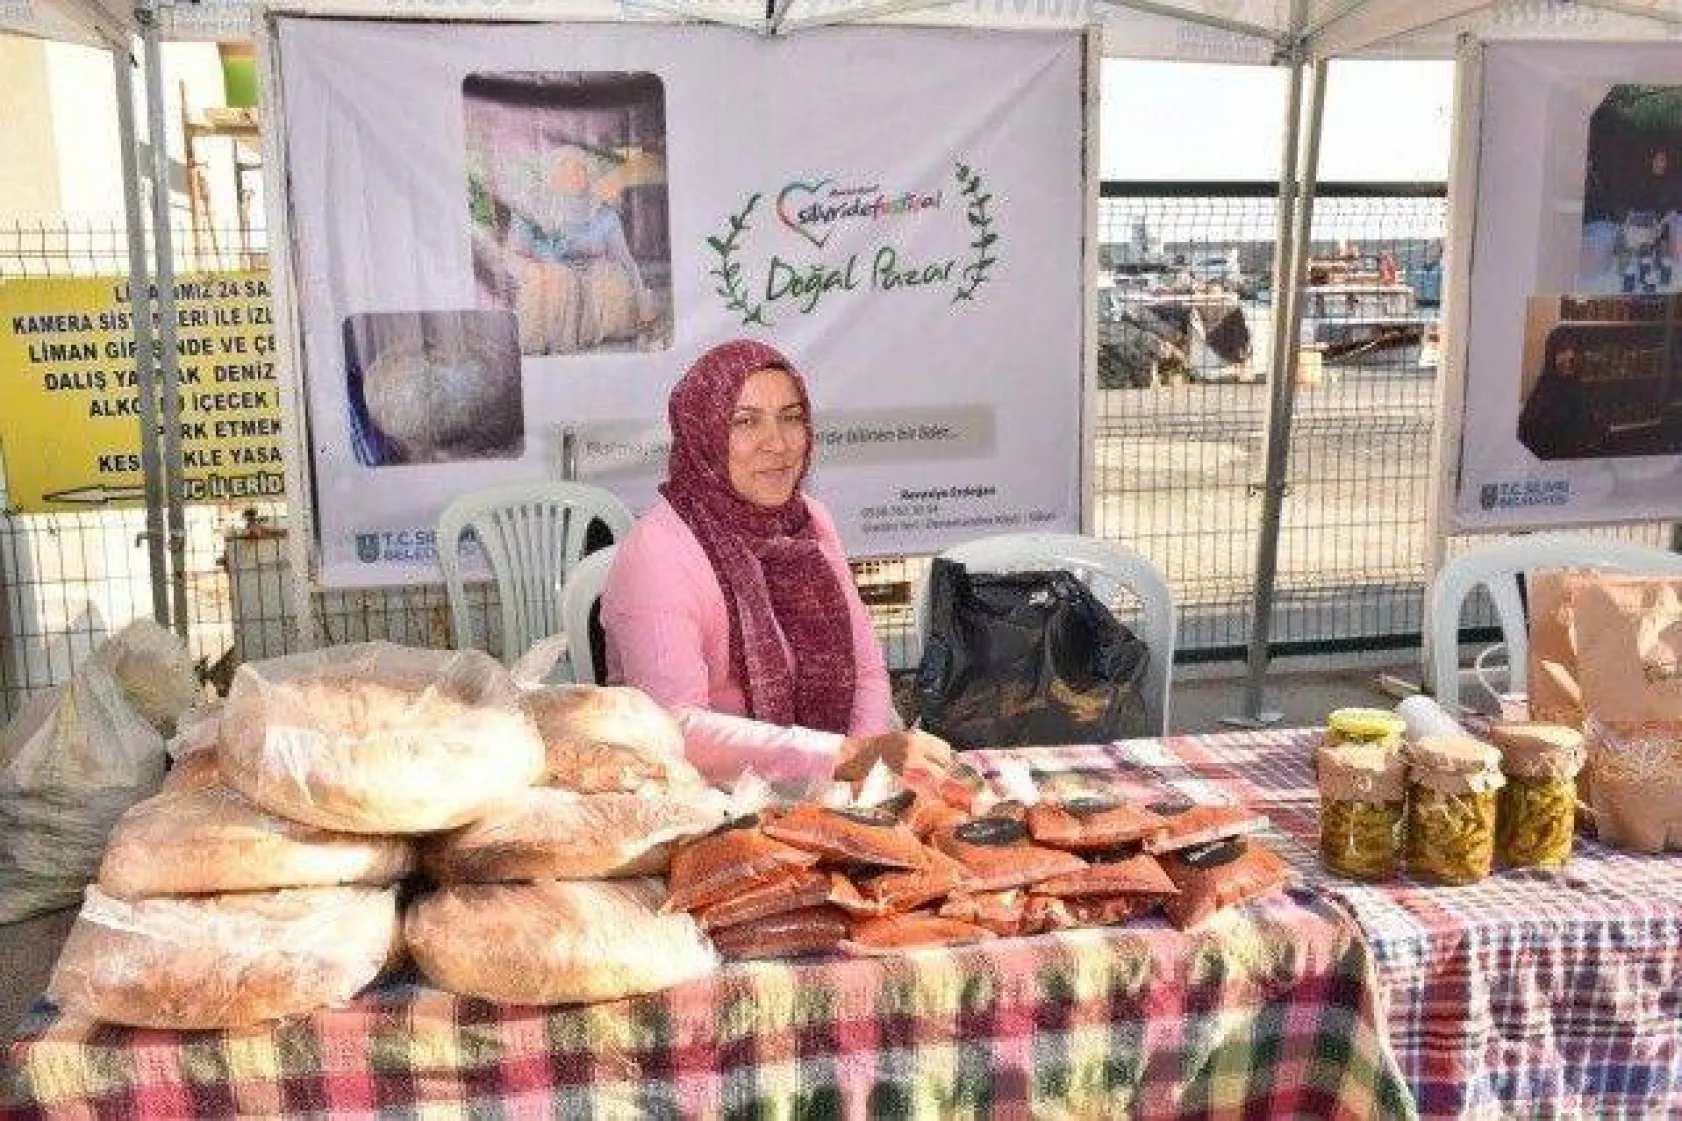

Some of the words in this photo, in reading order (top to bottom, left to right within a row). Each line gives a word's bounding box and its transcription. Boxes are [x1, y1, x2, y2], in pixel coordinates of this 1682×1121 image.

[873, 246, 955, 290] Pazar
[113, 281, 213, 303] LİAIMIZ
[219, 281, 239, 298] 24
[12, 315, 93, 335] KAMERA
[28, 340, 98, 363] LİMAN
[221, 336, 248, 354] VE
[113, 367, 201, 388] YAAK
[156, 423, 209, 440] PRK
[98, 450, 223, 472] KESKLE
